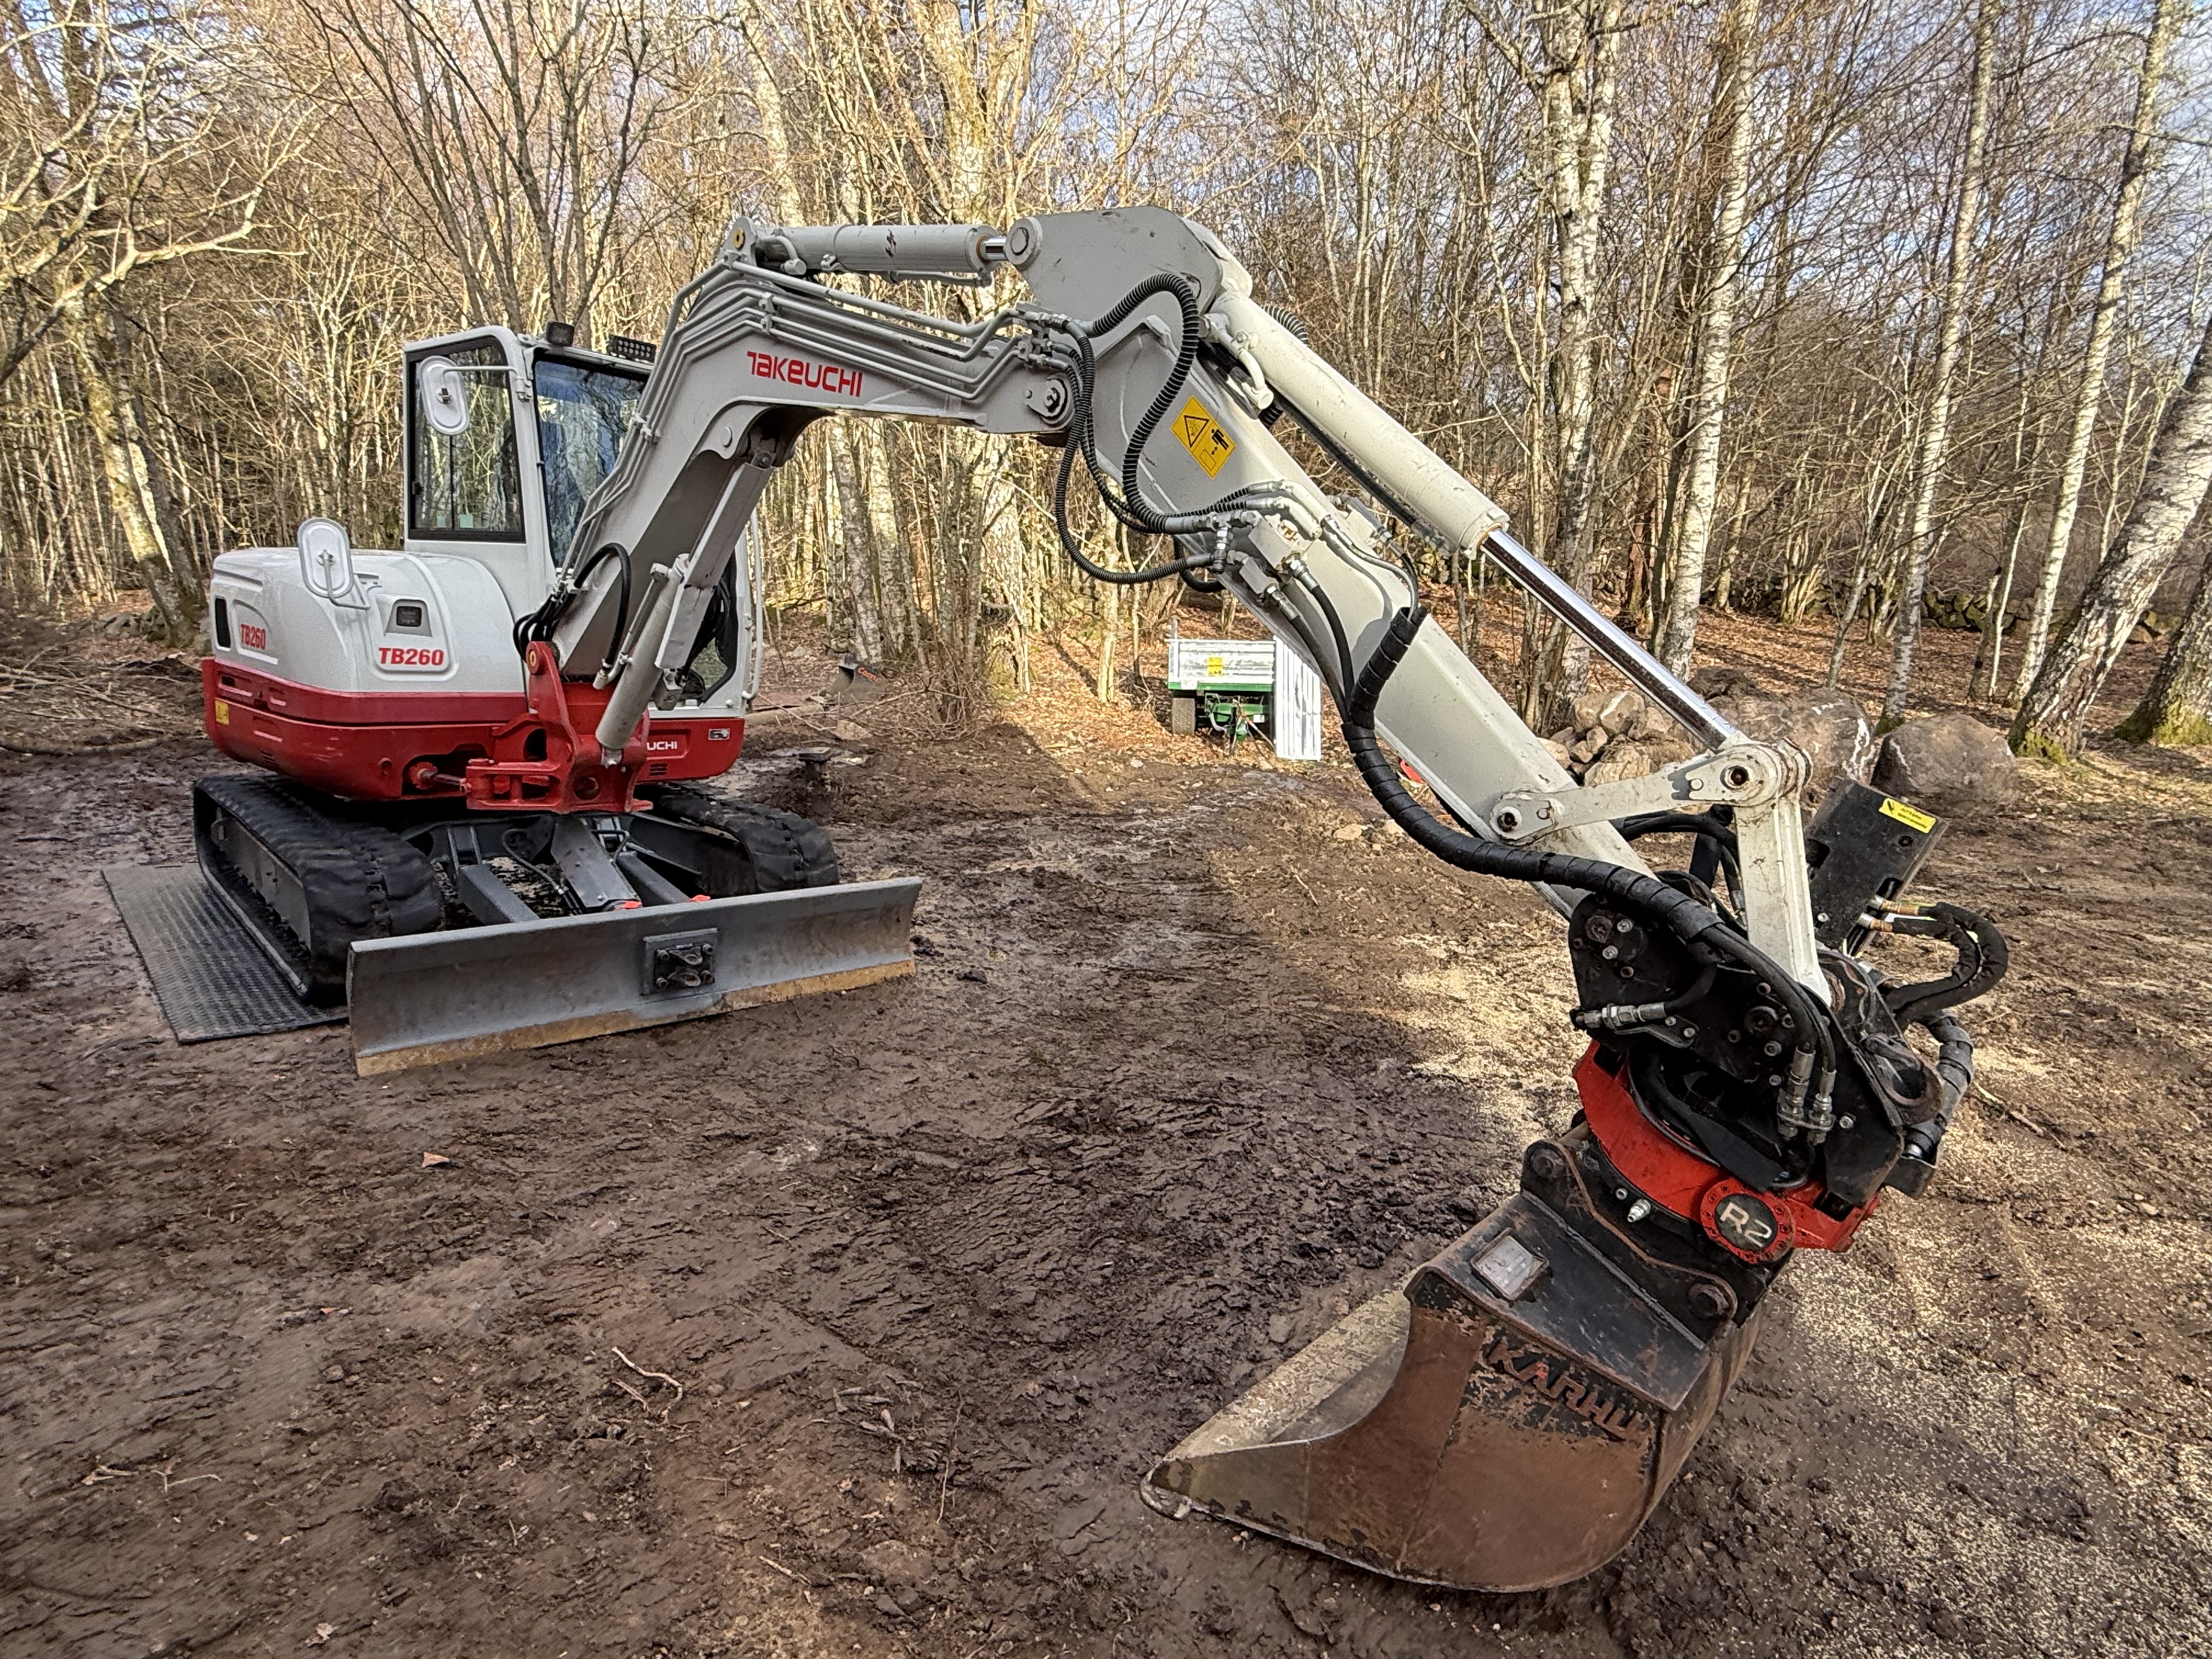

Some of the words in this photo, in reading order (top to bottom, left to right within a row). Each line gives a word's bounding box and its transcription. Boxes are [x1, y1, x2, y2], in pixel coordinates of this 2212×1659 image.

[240, 624, 266, 650] TB260
[379, 648, 444, 666] TB260
[646, 741, 678, 751] UCHI
[1720, 1202, 1772, 1248] R2
[1487, 1337, 1645, 1441] KARHU
